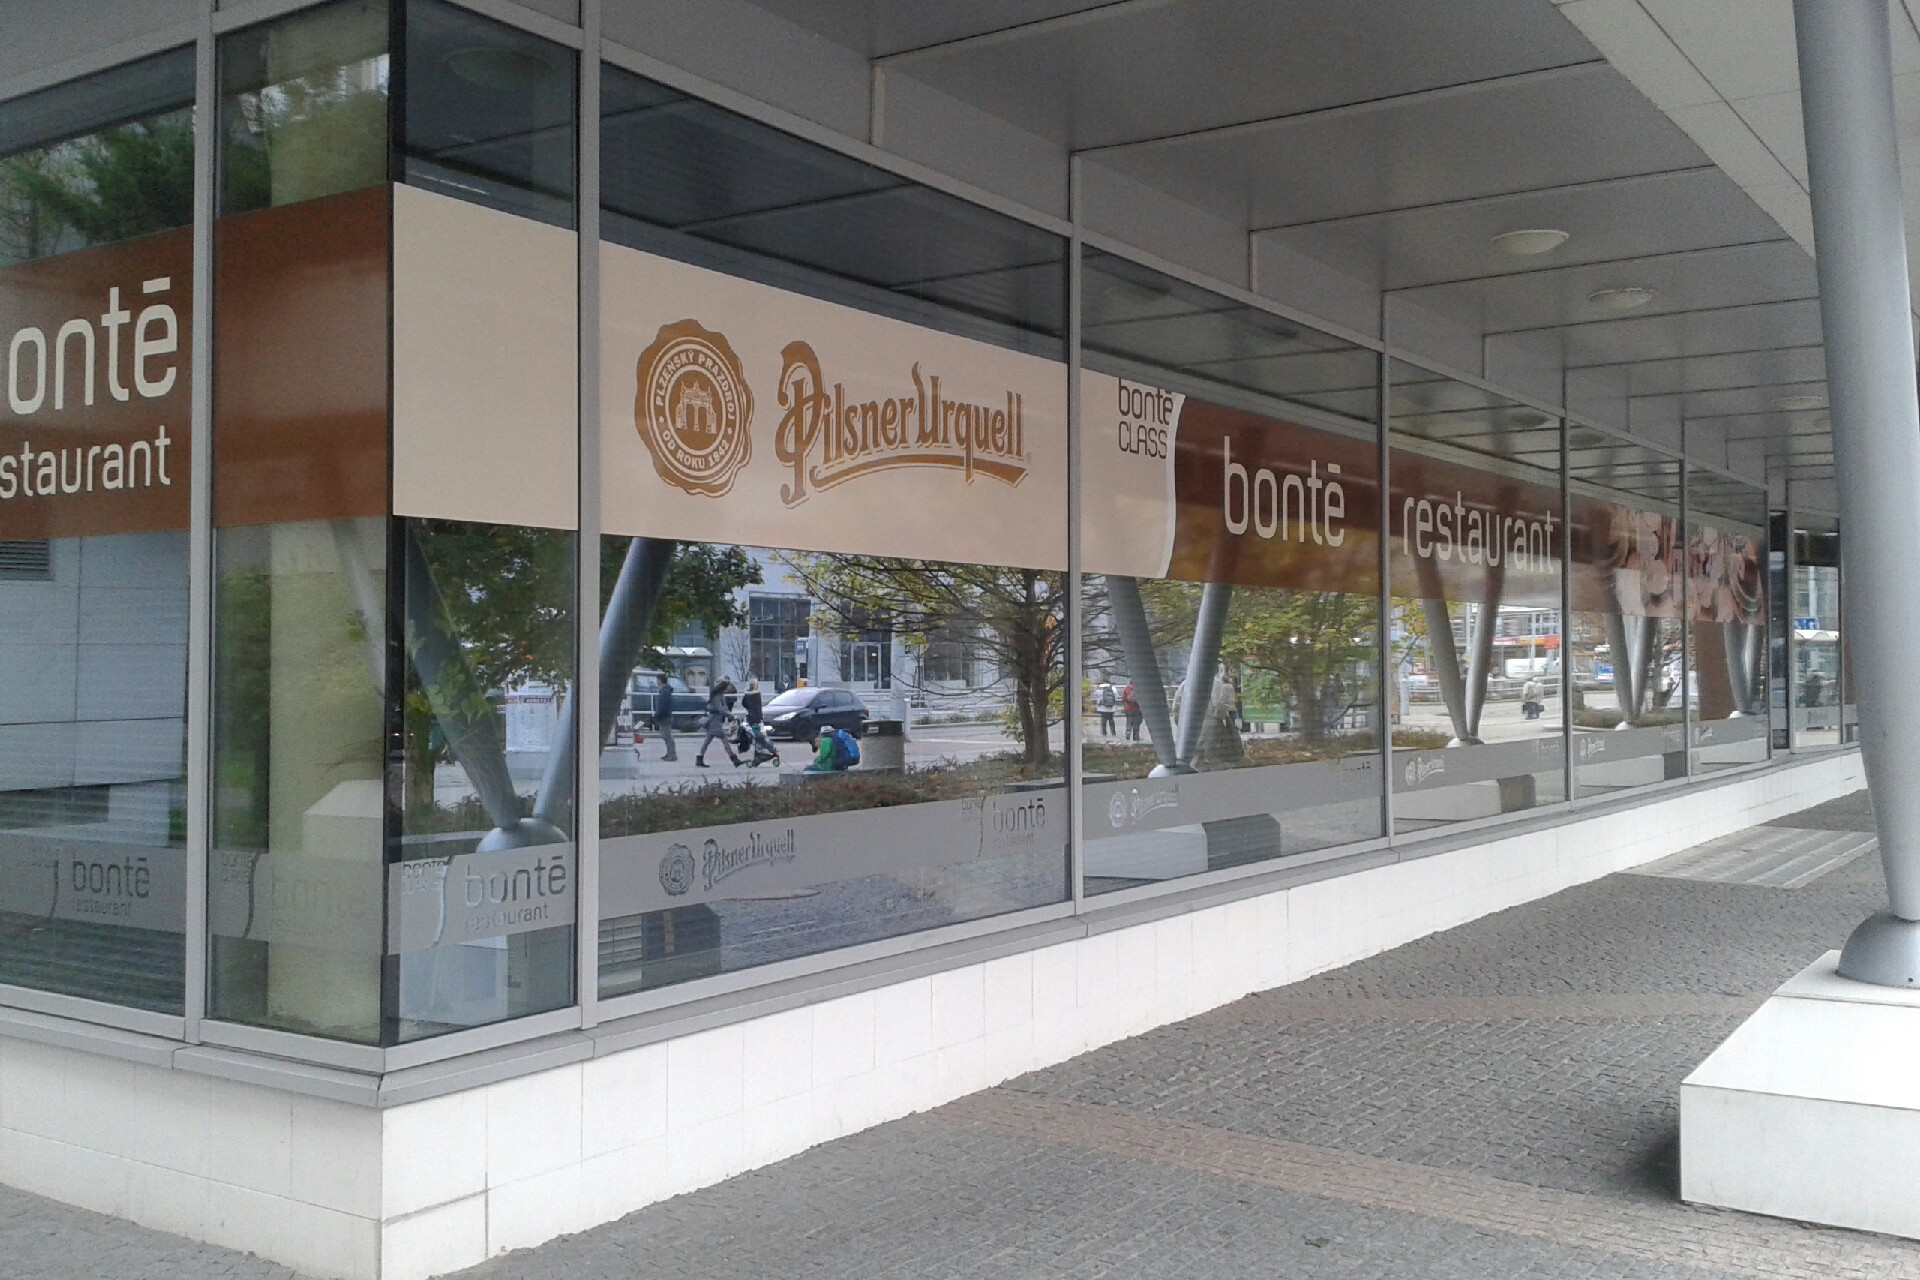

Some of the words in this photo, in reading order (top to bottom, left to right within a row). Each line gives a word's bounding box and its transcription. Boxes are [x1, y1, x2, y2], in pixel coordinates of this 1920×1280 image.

[698, 353, 735, 420] PRAZDROJ
[662, 430, 676, 451] OD
[676, 448, 705, 469] ROKU
[707, 439, 730, 467] 1842
[775, 340, 915, 509] Pilsner
[911, 360, 1025, 486] Urquell
[1118, 420, 1168, 459] CLASS
[0, 424, 171, 499] staurant
[1403, 490, 1554, 574] restaurant
[702, 838, 751, 891] Pilsner
